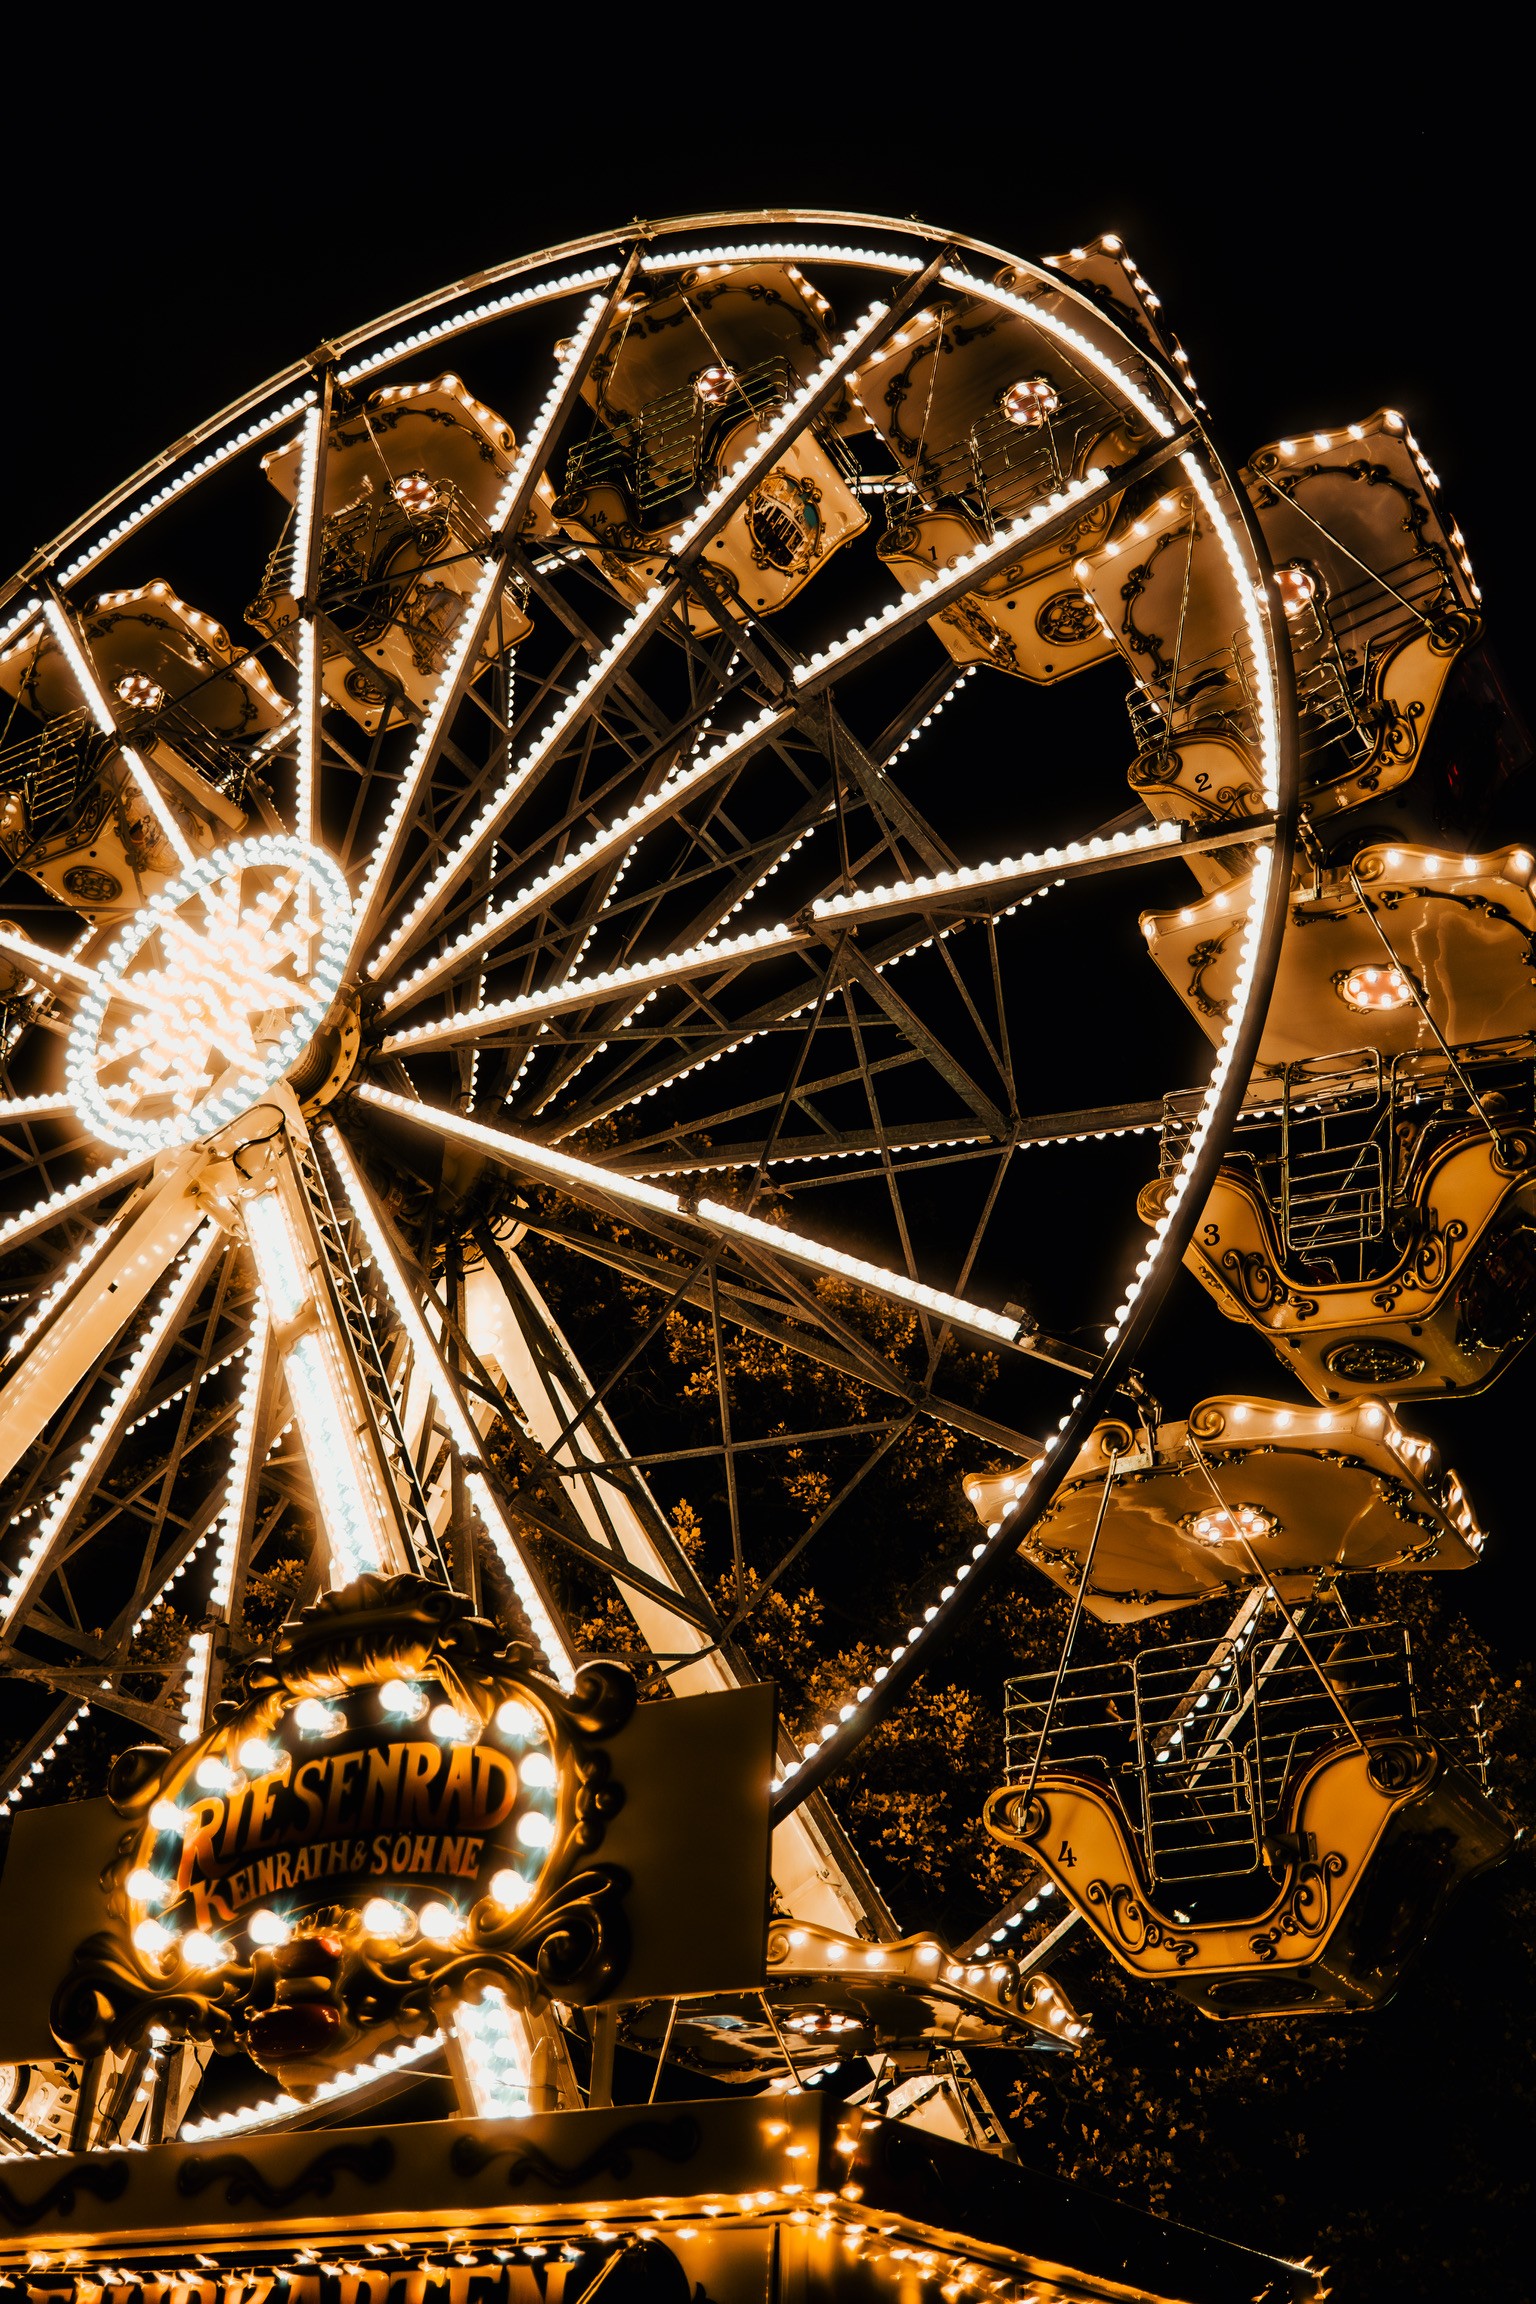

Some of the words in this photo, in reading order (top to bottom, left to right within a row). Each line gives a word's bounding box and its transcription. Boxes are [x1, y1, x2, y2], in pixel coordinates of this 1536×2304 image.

[590, 510, 608, 528] 14
[927, 545, 938, 562] 1
[1194, 772, 1213, 793] 2
[1203, 1223, 1221, 1247] 3
[177, 1741, 518, 1893] RIESENRAD
[1057, 1840, 1078, 1868] 4
